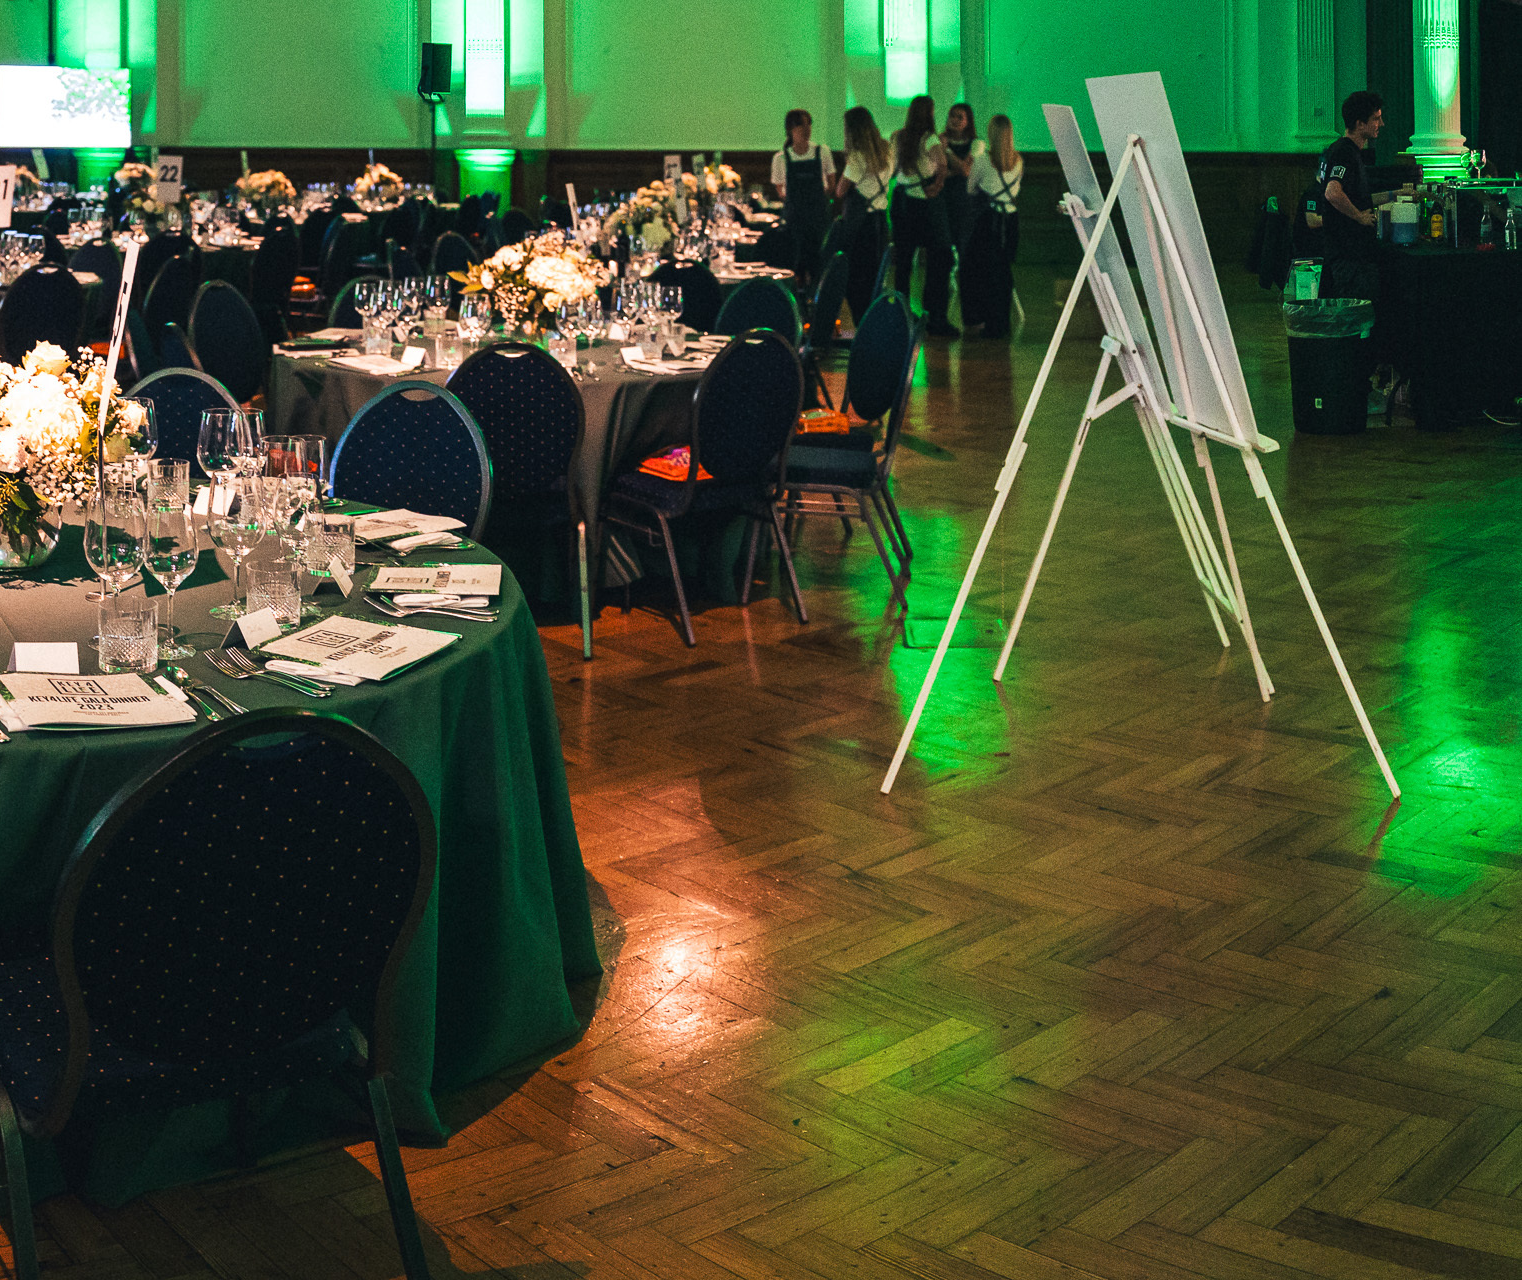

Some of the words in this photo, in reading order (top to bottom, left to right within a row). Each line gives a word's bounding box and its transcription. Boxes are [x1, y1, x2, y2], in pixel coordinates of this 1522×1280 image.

[159, 164, 178, 183] 22
[28, 695, 78, 704] KEY4LIFE
[80, 696, 110, 704] GALA
[109, 695, 151, 704] DINNER
[76, 703, 115, 711] 2023
